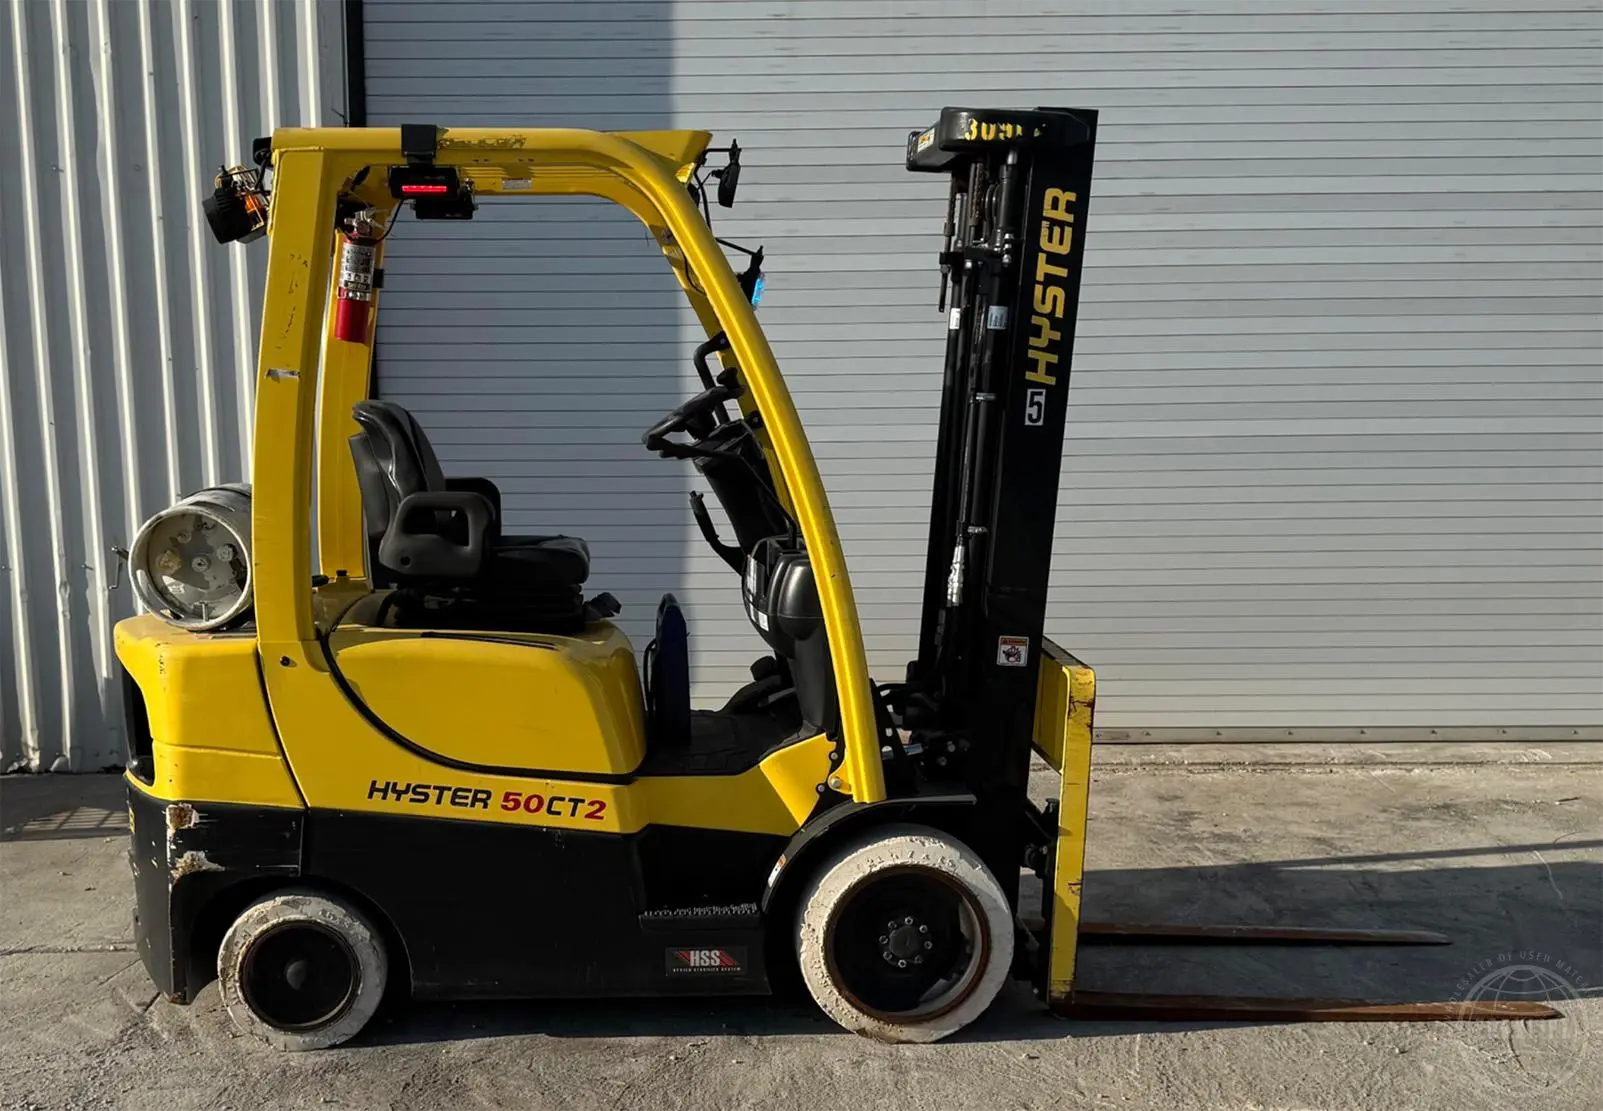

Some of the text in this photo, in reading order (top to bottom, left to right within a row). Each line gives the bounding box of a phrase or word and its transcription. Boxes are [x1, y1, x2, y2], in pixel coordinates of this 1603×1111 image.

[1025, 187, 1076, 386] HYSTER
[1026, 390, 1044, 424] 5
[367, 780, 607, 820] HYSTER 50CT2
[689, 949, 721, 967] HSS
